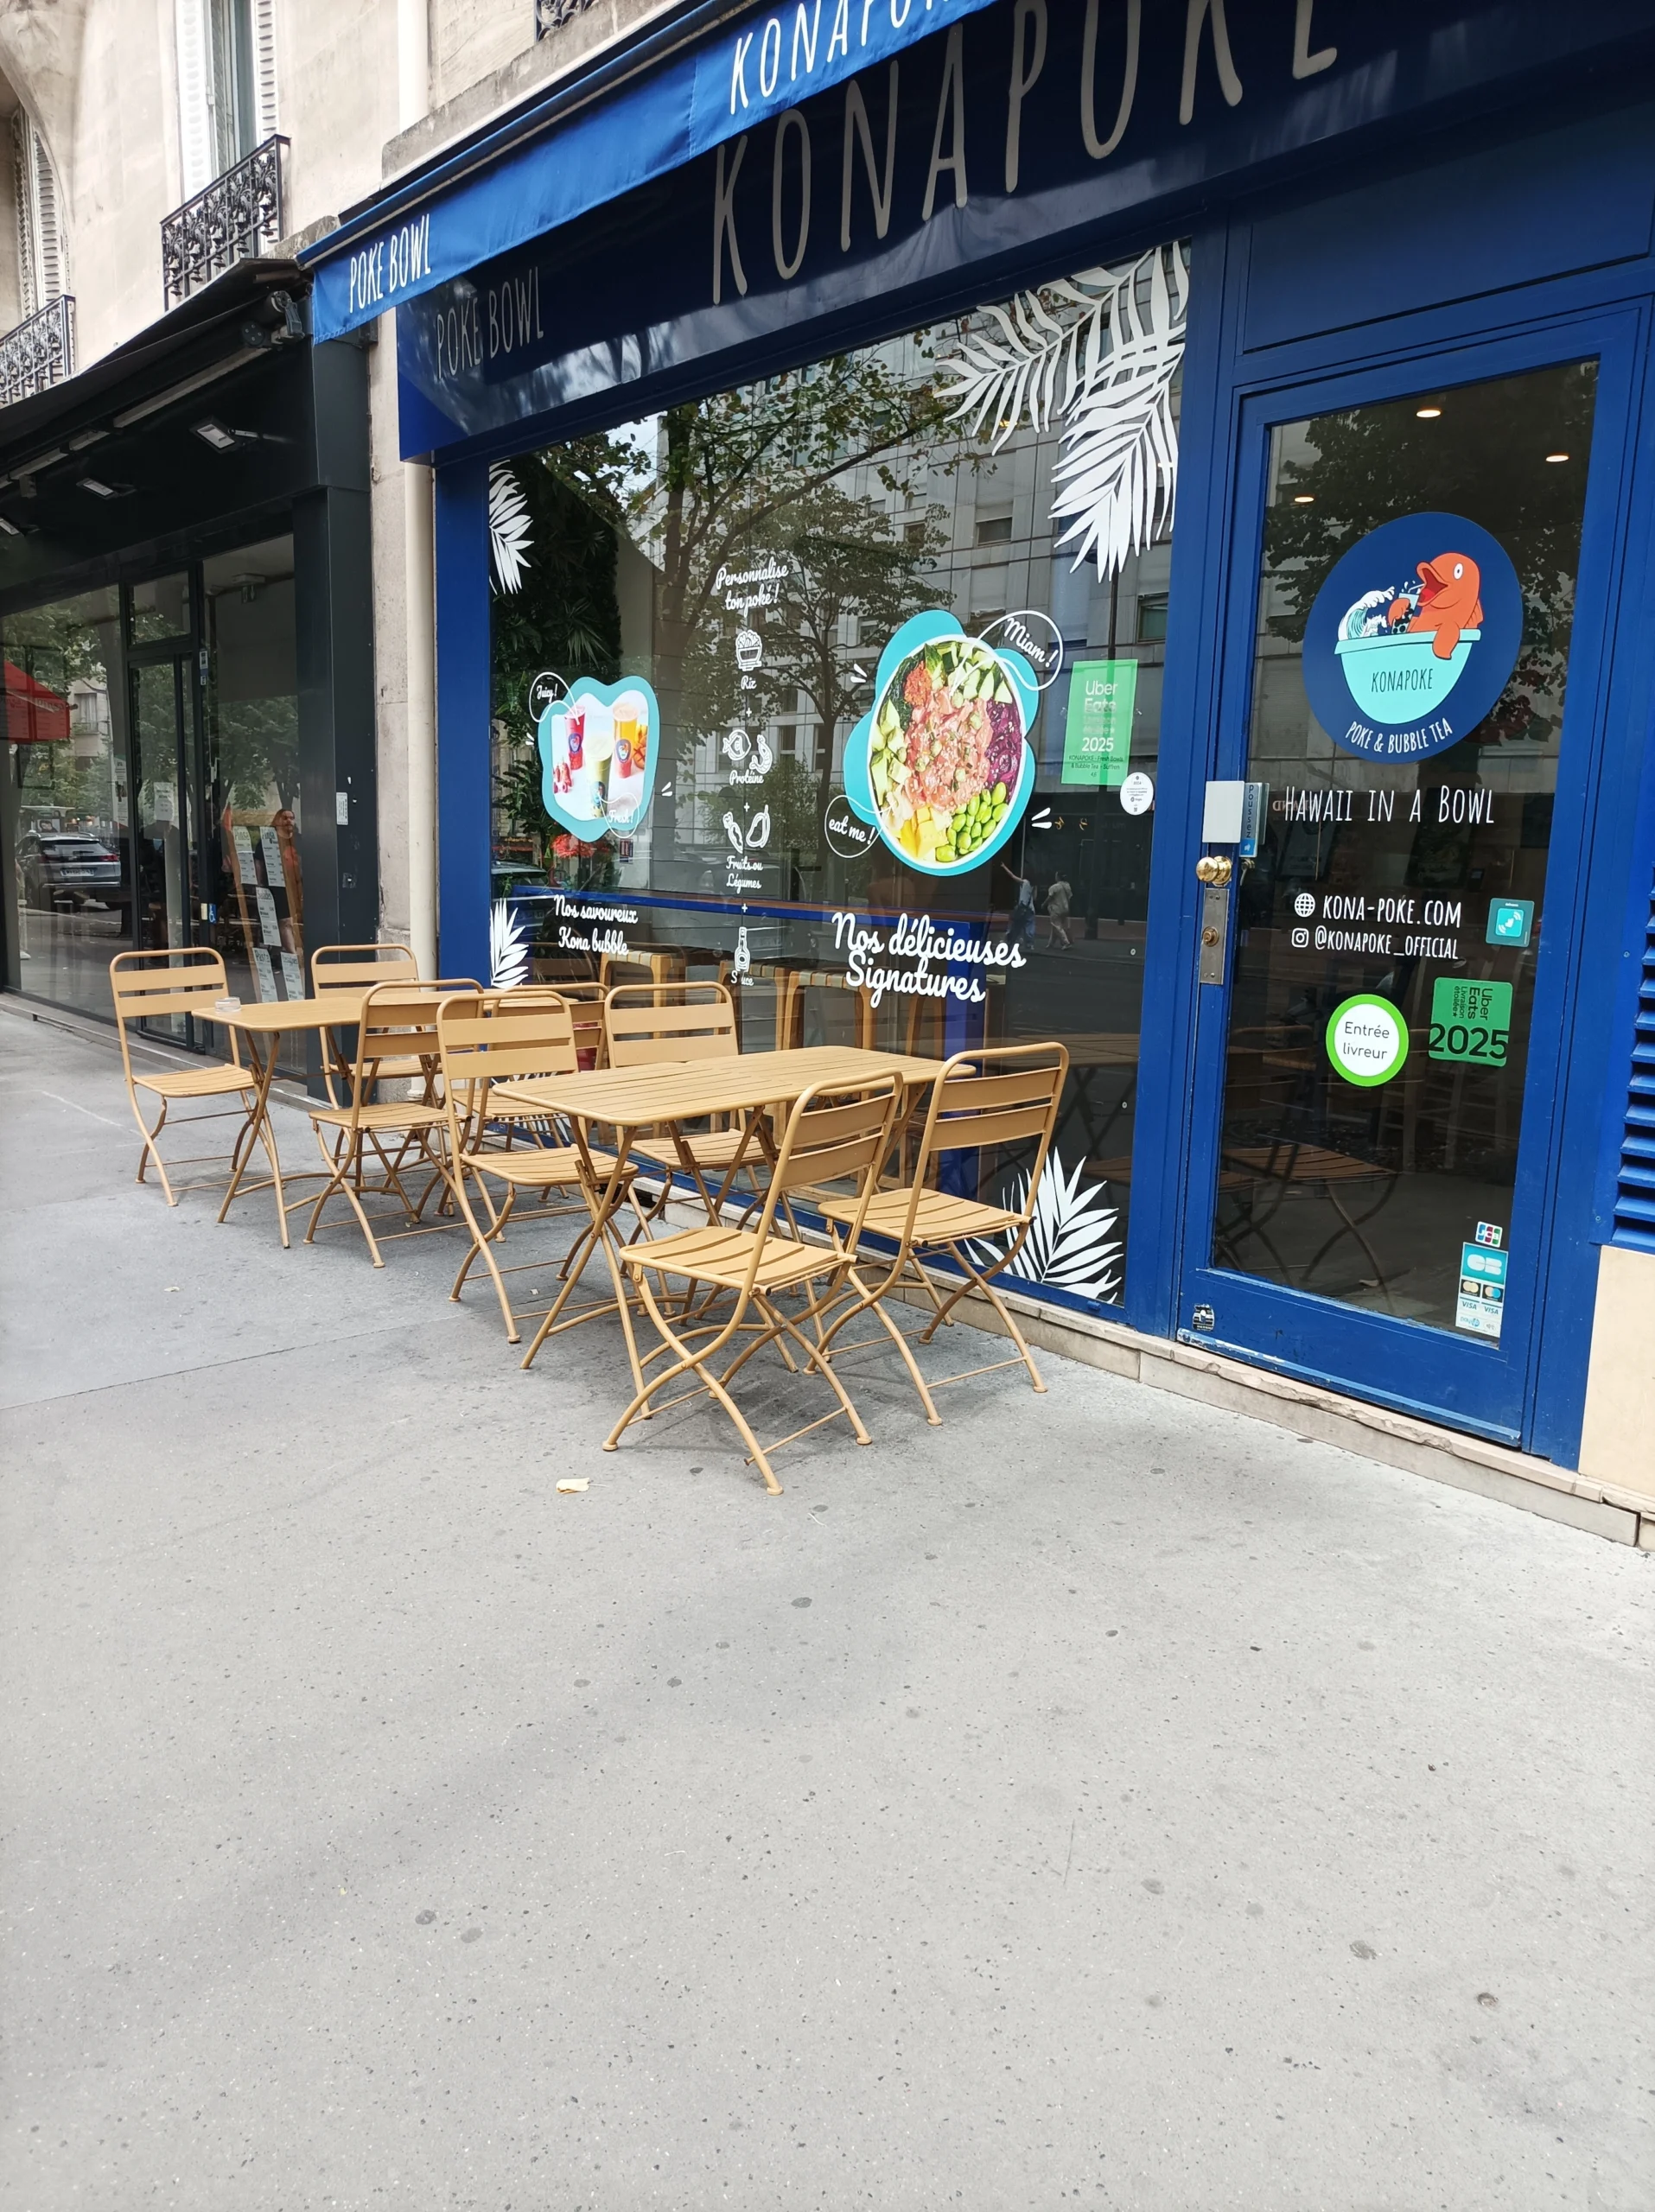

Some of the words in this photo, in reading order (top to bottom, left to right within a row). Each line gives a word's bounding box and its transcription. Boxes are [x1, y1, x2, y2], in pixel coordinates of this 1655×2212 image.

[349, 241, 384, 313] POKE
[388, 213, 431, 294] BOWL
[436, 297, 481, 379] POKE
[488, 266, 544, 359] BOWL
[716, 556, 789, 590] Personnalise
[725, 590, 744, 610] ton
[741, 675, 757, 690] Riz
[1085, 681, 1117, 696] Uber
[1372, 668, 1434, 693] KONAPOKE
[1082, 737, 1114, 752] 2025
[1346, 721, 1372, 748] POKE
[1373, 734, 1384, 753] &
[1387, 728, 1429, 753] BUBBLE
[1429, 717, 1453, 744] TEA
[729, 769, 764, 785] Protéine
[1284, 786, 1353, 823] HAWAII
[1368, 789, 1393, 823] IN
[1409, 789, 1422, 823] A
[1438, 785, 1494, 824] BOWL
[828, 818, 847, 836] eat
[726, 855, 750, 872] Fruits
[726, 874, 761, 893] Légumes
[553, 894, 577, 920] Nos
[581, 906, 639, 925] savoureux
[557, 925, 589, 951] Kona
[591, 929, 629, 956] bubble
[831, 912, 883, 953] Nos
[888, 913, 1026, 967] délicieuses
[731, 970, 754, 986] Suce
[845, 950, 985, 1008] Signatures
[1459, 986, 1467, 1019] Livraison
[1467, 987, 1480, 1020] Eats
[1480, 988, 1493, 1020] Uber
[1344, 1021, 1390, 1039] Entrée
[1429, 1023, 1509, 1059] 2025
[1342, 1043, 1388, 1061] livreur
[1462, 1300, 1477, 1310] VISA
[1484, 1306, 1499, 1315] VISA
